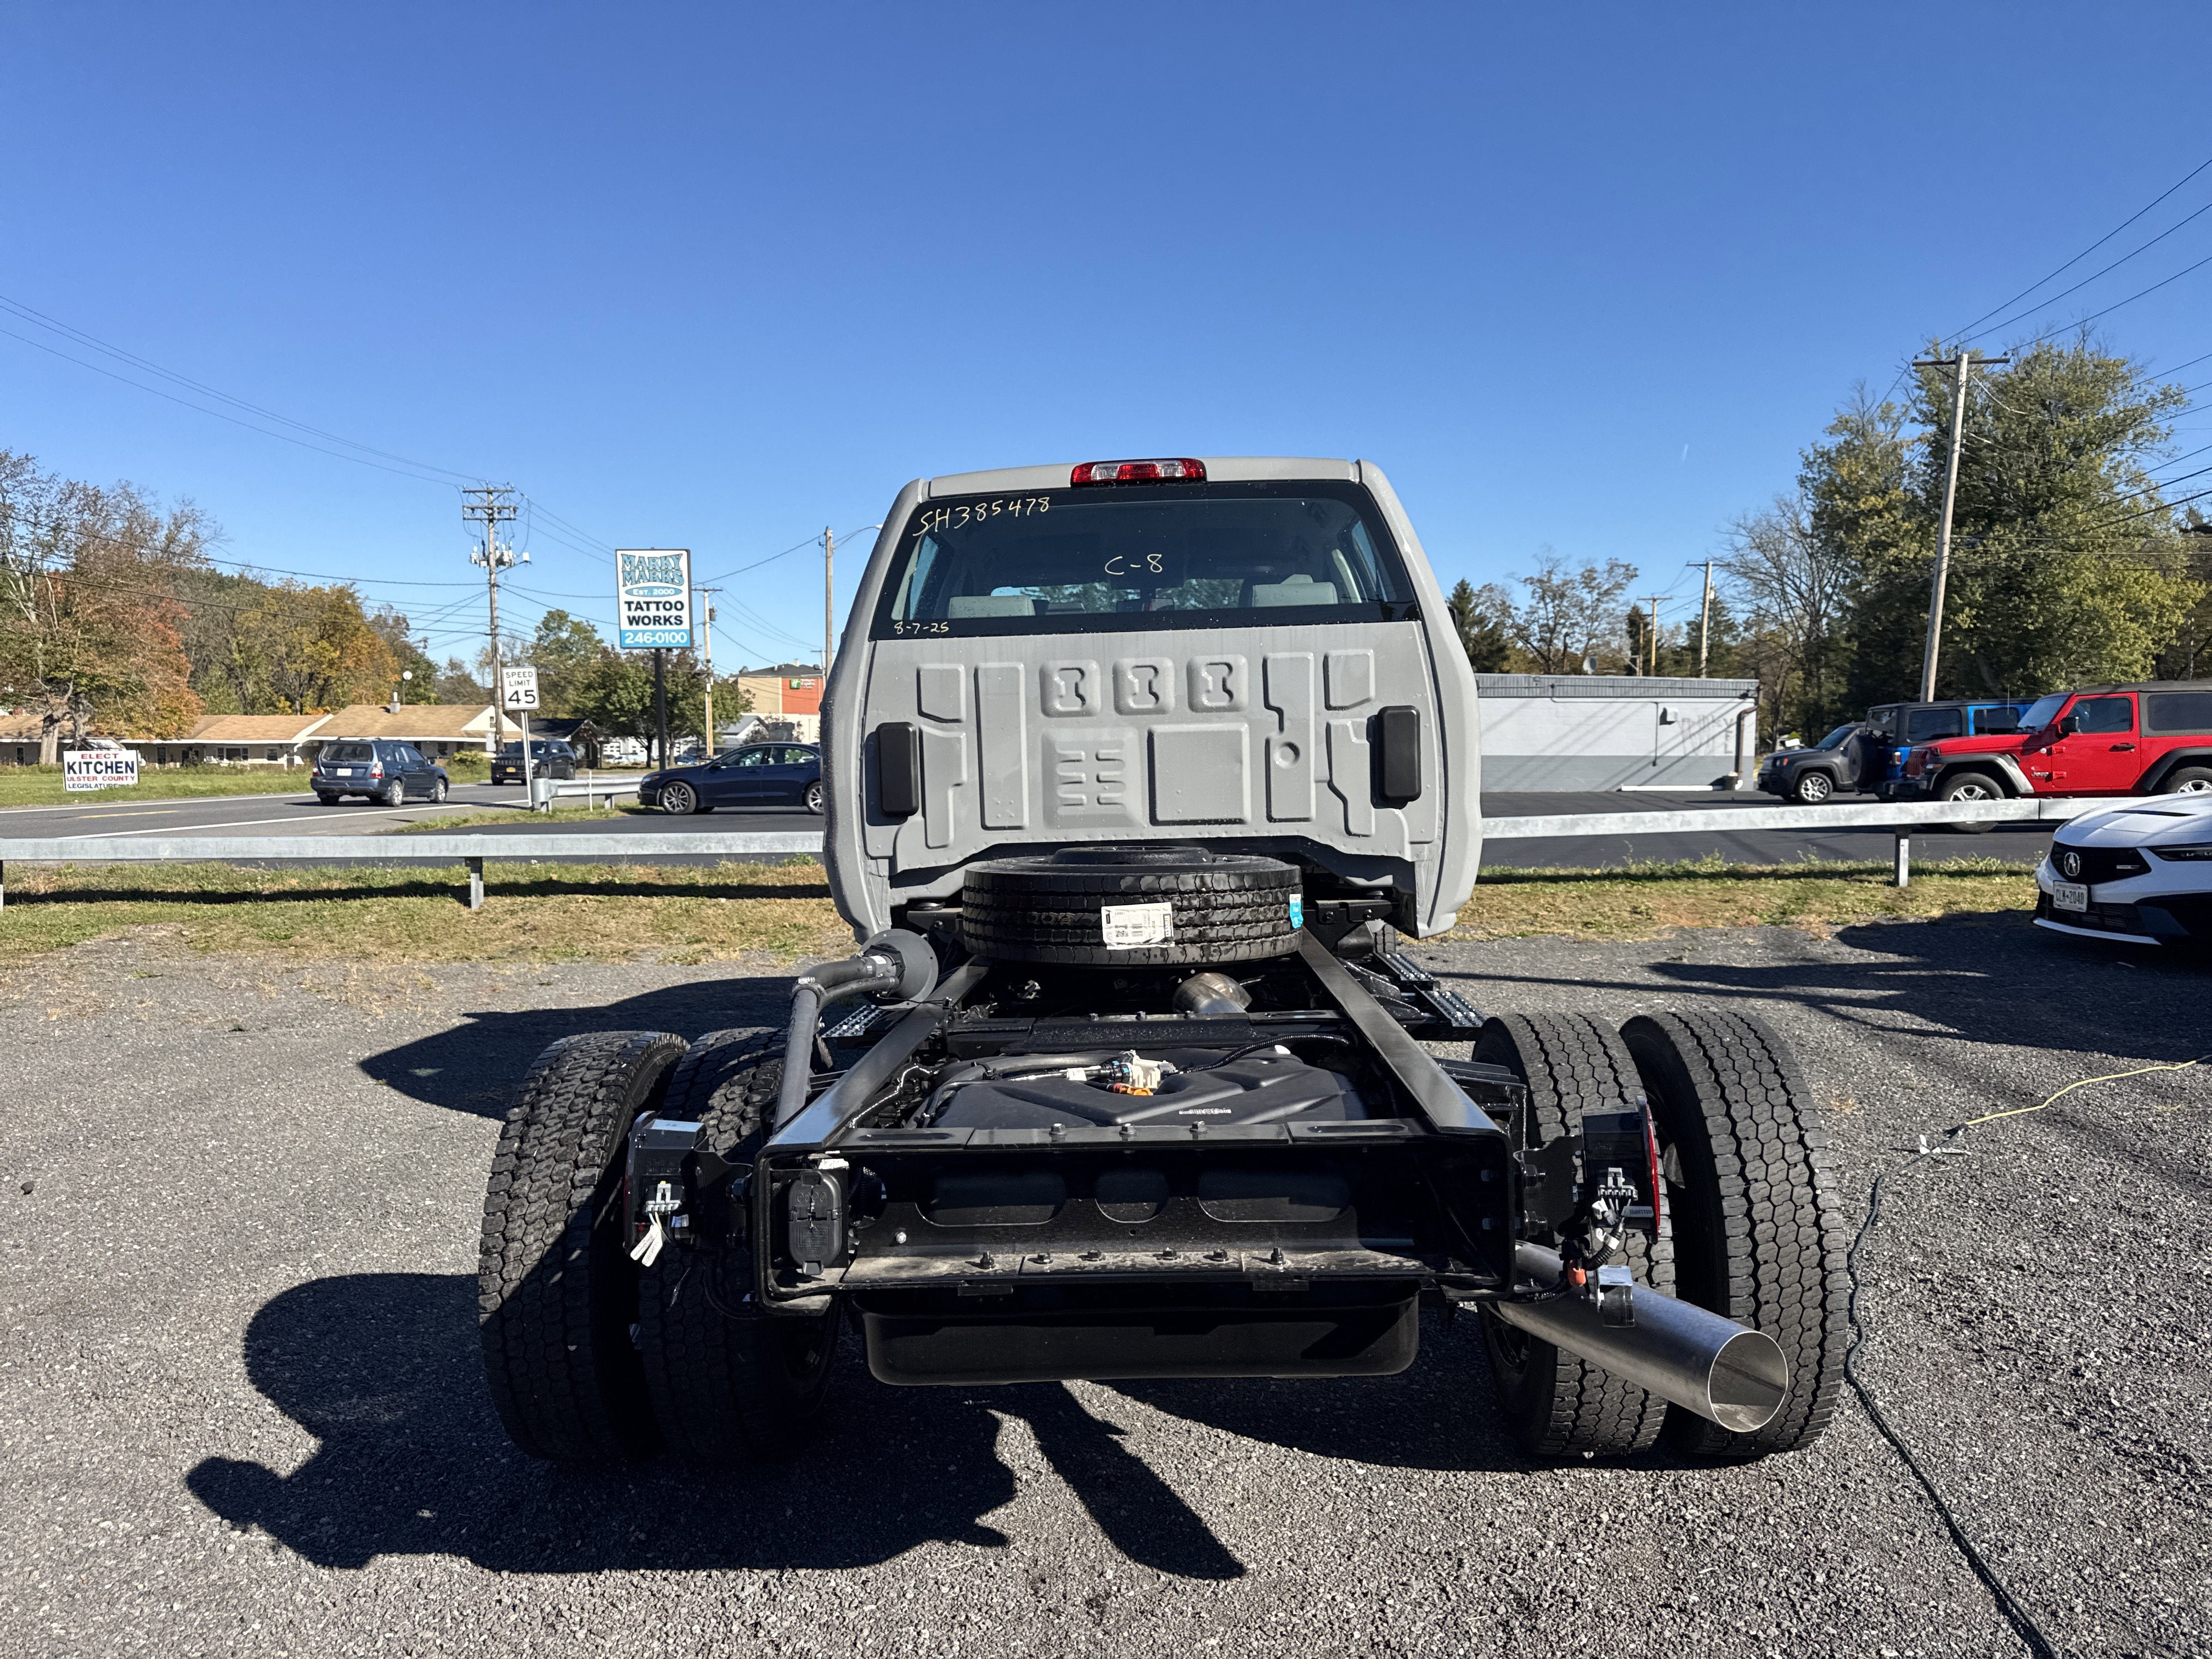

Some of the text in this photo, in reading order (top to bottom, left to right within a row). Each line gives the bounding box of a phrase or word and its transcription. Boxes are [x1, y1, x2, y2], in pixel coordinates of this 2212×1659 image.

[912, 496, 1050, 537] SH385478
[620, 553, 684, 571] MARKY
[1104, 554, 1163, 575] C-8
[622, 569, 685, 587] MARKS
[624, 601, 684, 612] TATTOO
[627, 615, 684, 626] WORKS
[894, 620, 949, 635] 8-7-25
[625, 631, 687, 644] 246-0100
[508, 690, 536, 704] 45
[67, 761, 134, 775] KITCHEN
